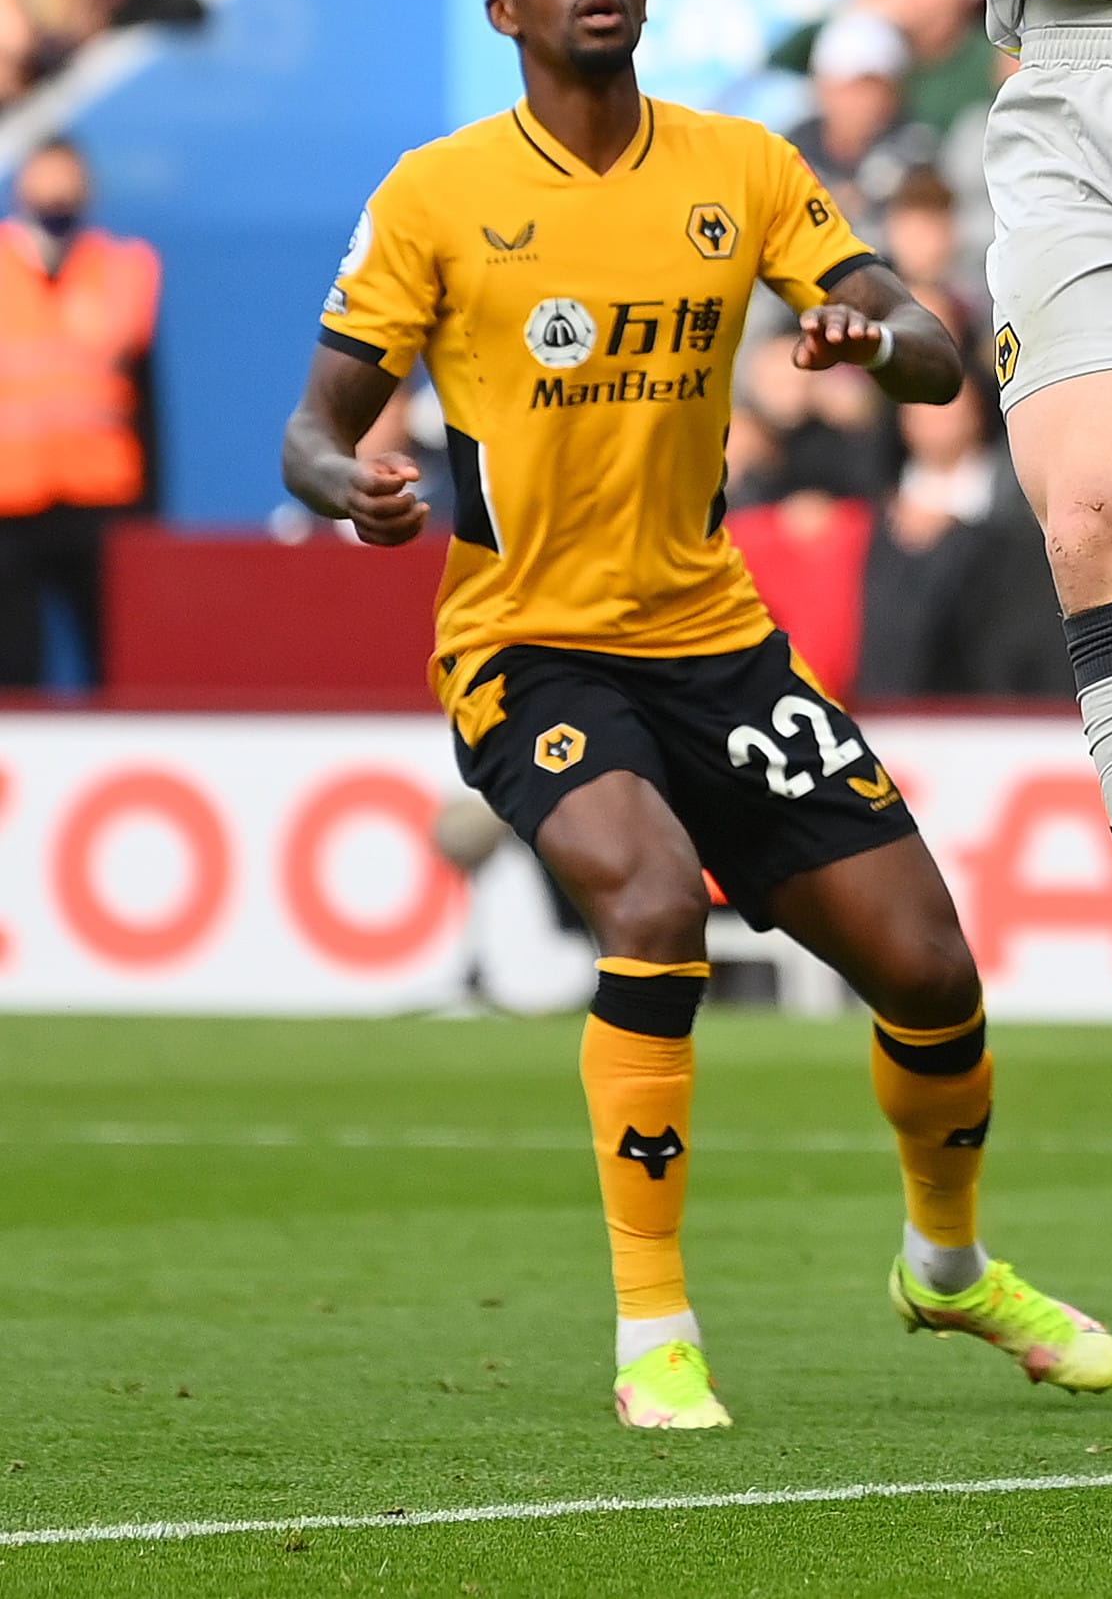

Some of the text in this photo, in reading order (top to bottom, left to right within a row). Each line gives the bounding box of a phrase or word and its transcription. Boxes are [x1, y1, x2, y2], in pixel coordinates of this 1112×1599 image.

[605, 297, 723, 356] 万博
[530, 367, 711, 409] ManBetX
[727, 695, 864, 799] 22
[0, 761, 466, 973] OO
